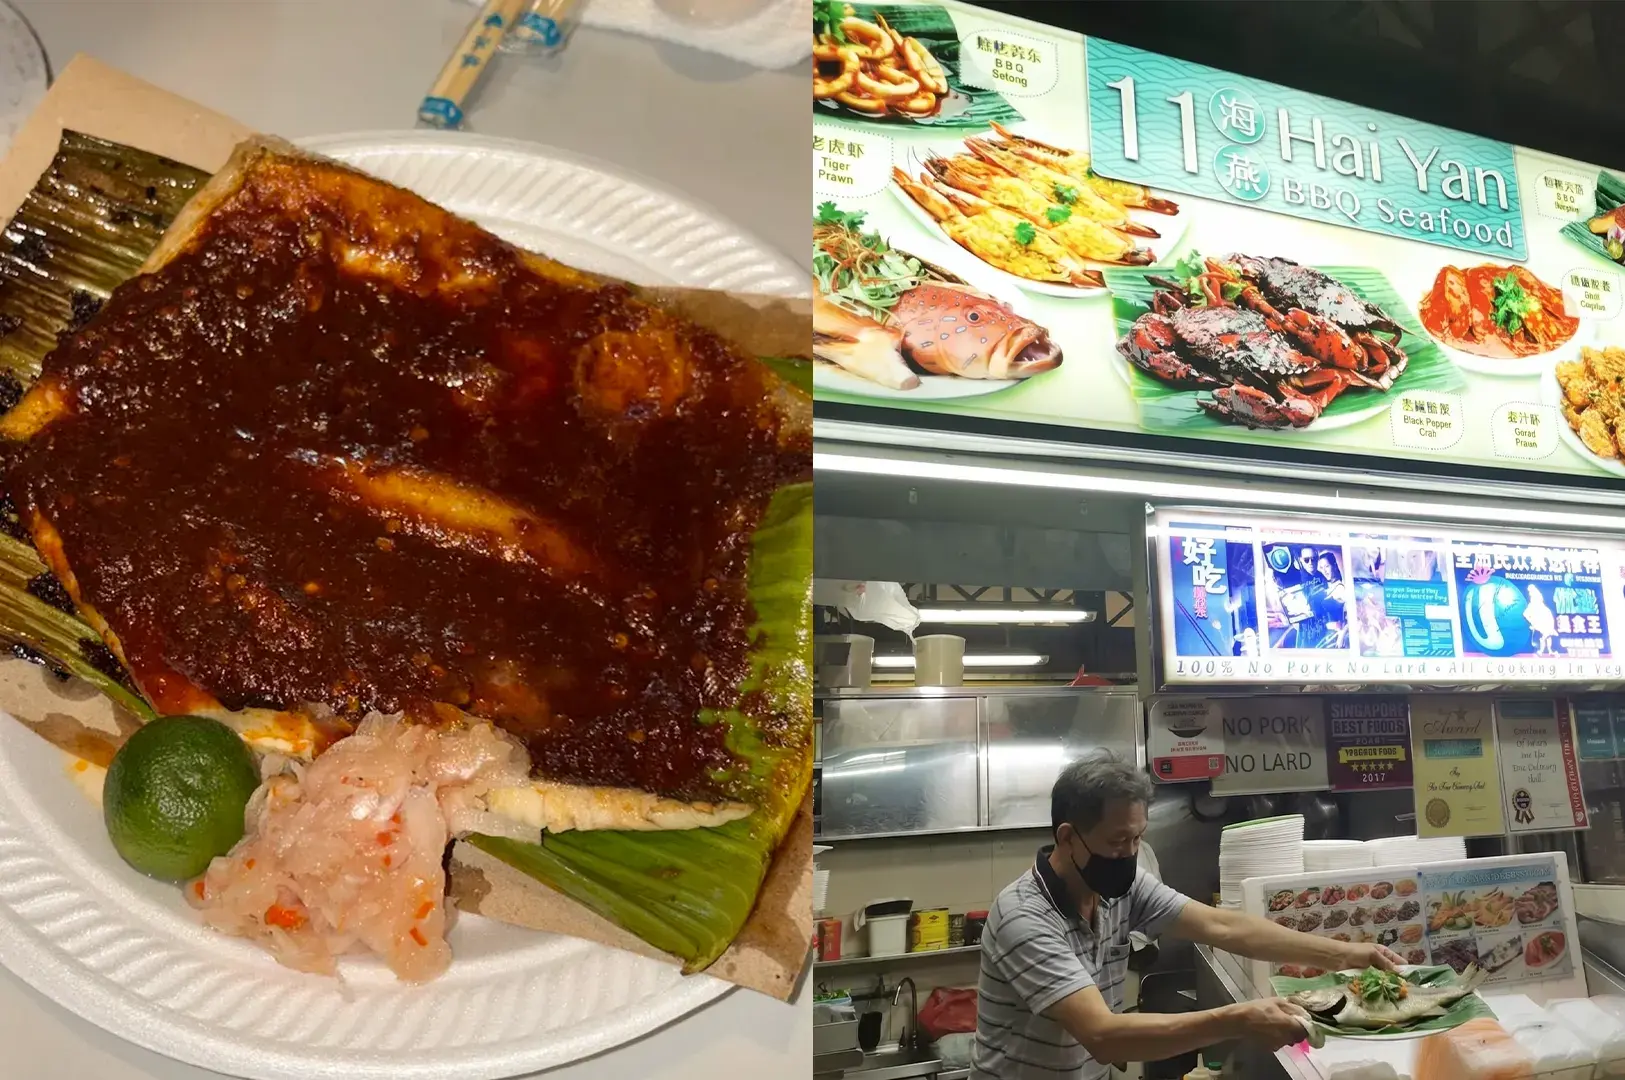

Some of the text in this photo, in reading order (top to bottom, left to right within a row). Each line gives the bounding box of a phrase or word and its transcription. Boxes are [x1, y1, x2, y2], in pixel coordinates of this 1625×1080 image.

[995, 58, 1024, 74] BBQ
[821, 157, 851, 171] Tiger
[1278, 108, 1509, 210] Hai Yan
[818, 169, 854, 184] Prawn
[1283, 178, 1514, 248] BBQ Seafood
[1403, 415, 1452, 430] Black Pepper
[1176, 660, 1233, 674] 100%
[1248, 661, 1273, 674] No
[1287, 661, 1334, 674] Pork
[1347, 661, 1370, 673] No
[1384, 662, 1427, 674] Lard
[1448, 662, 1474, 674] All
[1486, 662, 1557, 675] Cooking
[1568, 662, 1584, 674] In
[1222, 716, 1311, 735] NO PORK
[1333, 720, 1363, 734] BEST
[1225, 752, 1312, 773] NO LARD
[1362, 773, 1386, 782] 2017
